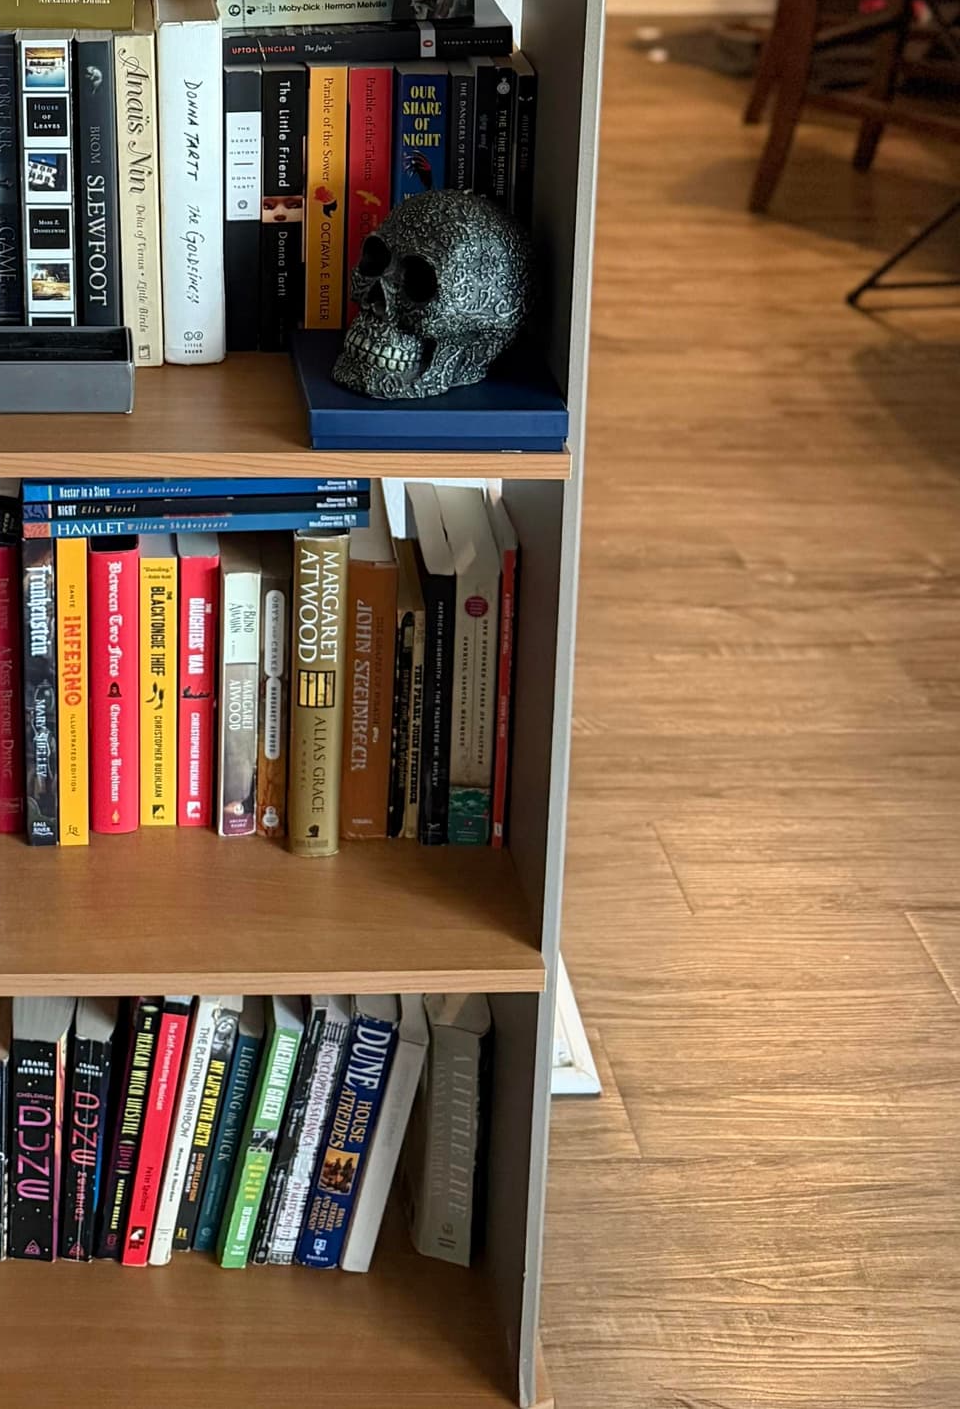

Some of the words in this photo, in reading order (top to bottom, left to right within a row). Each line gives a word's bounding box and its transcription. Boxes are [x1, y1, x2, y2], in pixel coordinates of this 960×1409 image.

[279, 3, 320, 12] Moby-Dick
[324, 2, 356, 10] Herman
[357, 0, 387, 9] Melville
[315, 44, 332, 52] Jungle
[58, 505, 76, 516] NIGHT
[81, 505, 101, 514] Elie
[105, 505, 136, 513] Wiesel
[60, 487, 79, 498] Nectar
[95, 487, 110, 497] Sieve
[57, 522, 125, 534] HAMLET
[170, 521, 228, 530] Shakespeare
[299, 549, 319, 664] ATWOOD
[320, 551, 339, 663] MARGARET
[64, 616, 82, 705] INFERNO
[202, 1027, 210, 1044] THE
[17, 1067, 54, 1076] HERBERT
[190, 1046, 205, 1091] PLATINUM
[270, 1035, 297, 1084] AMERICAN
[345, 1025, 391, 1089] DUNE
[181, 1096, 196, 1138] RAINBOW
[260, 1088, 286, 1120] GREEN
[329, 1088, 357, 1149] ATREIDES
[349, 1102, 372, 1143] HOUSE
